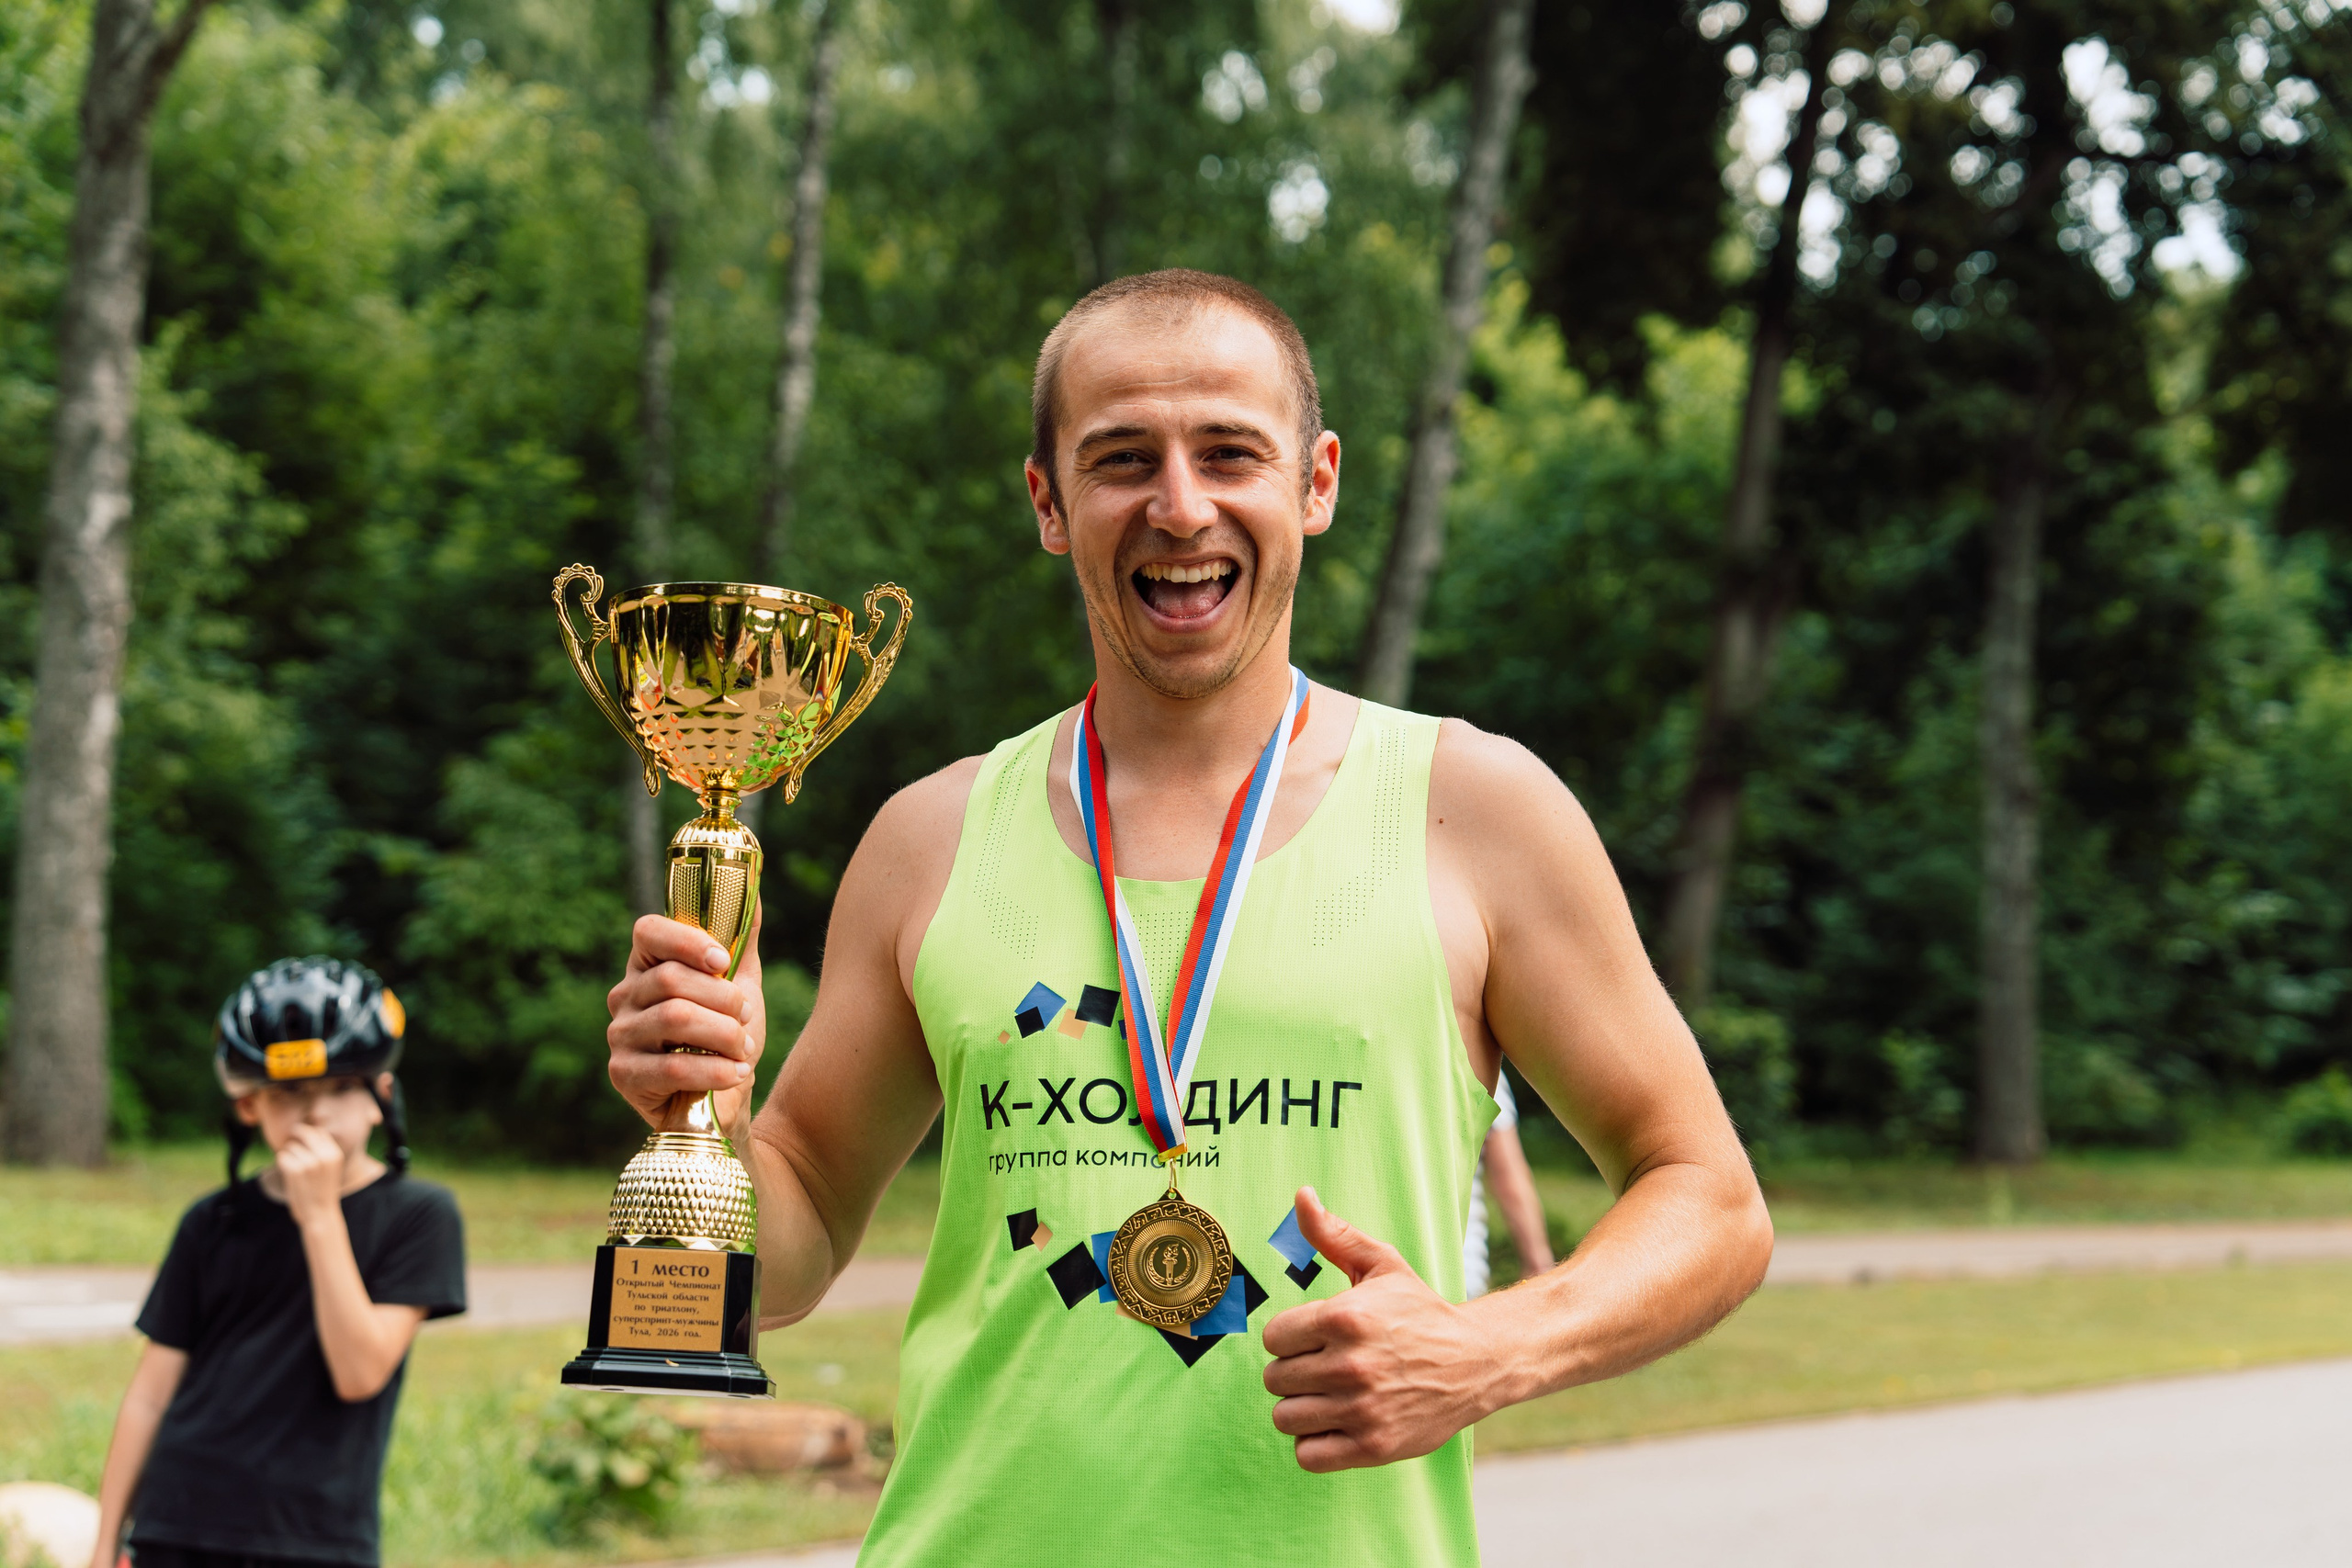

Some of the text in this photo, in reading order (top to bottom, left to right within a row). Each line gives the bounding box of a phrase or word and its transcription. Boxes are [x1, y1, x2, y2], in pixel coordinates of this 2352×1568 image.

[980, 1077, 1362, 1134] К-ХОДИНГ
[989, 1148, 1067, 1175] группа
[630, 1259, 709, 1278] 1 место
[616, 1278, 721, 1290] Открытый Чемпионат
[627, 1291, 710, 1302] Тульской области
[651, 1304, 699, 1314] триатлону,
[613, 1314, 719, 1326] суперспринт-мужчины
[629, 1326, 651, 1337] Тула,
[657, 1328, 679, 1337] 2026
